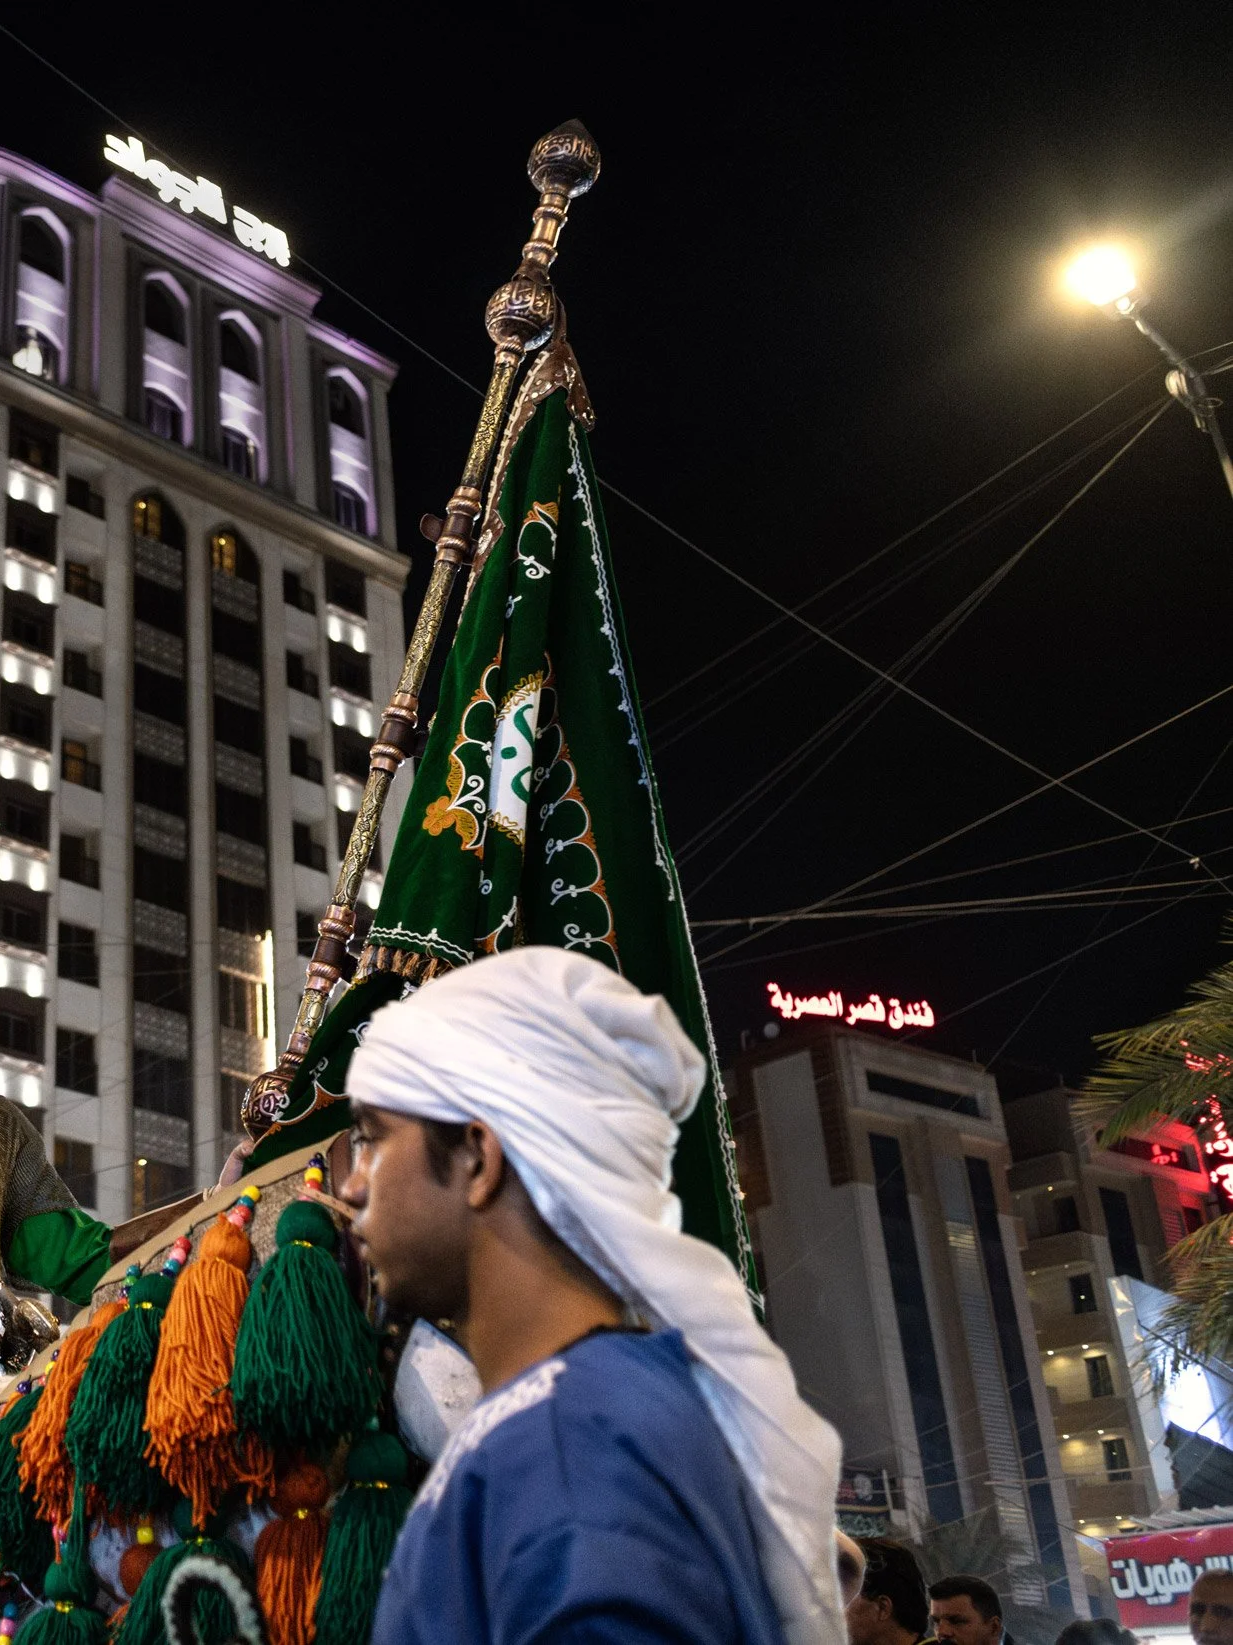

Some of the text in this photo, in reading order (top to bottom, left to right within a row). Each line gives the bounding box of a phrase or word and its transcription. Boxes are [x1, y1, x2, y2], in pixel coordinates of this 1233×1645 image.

[847, 994, 885, 1025] قصر
[889, 999, 934, 1029] فندق
[1110, 1556, 1194, 1606] هويات
